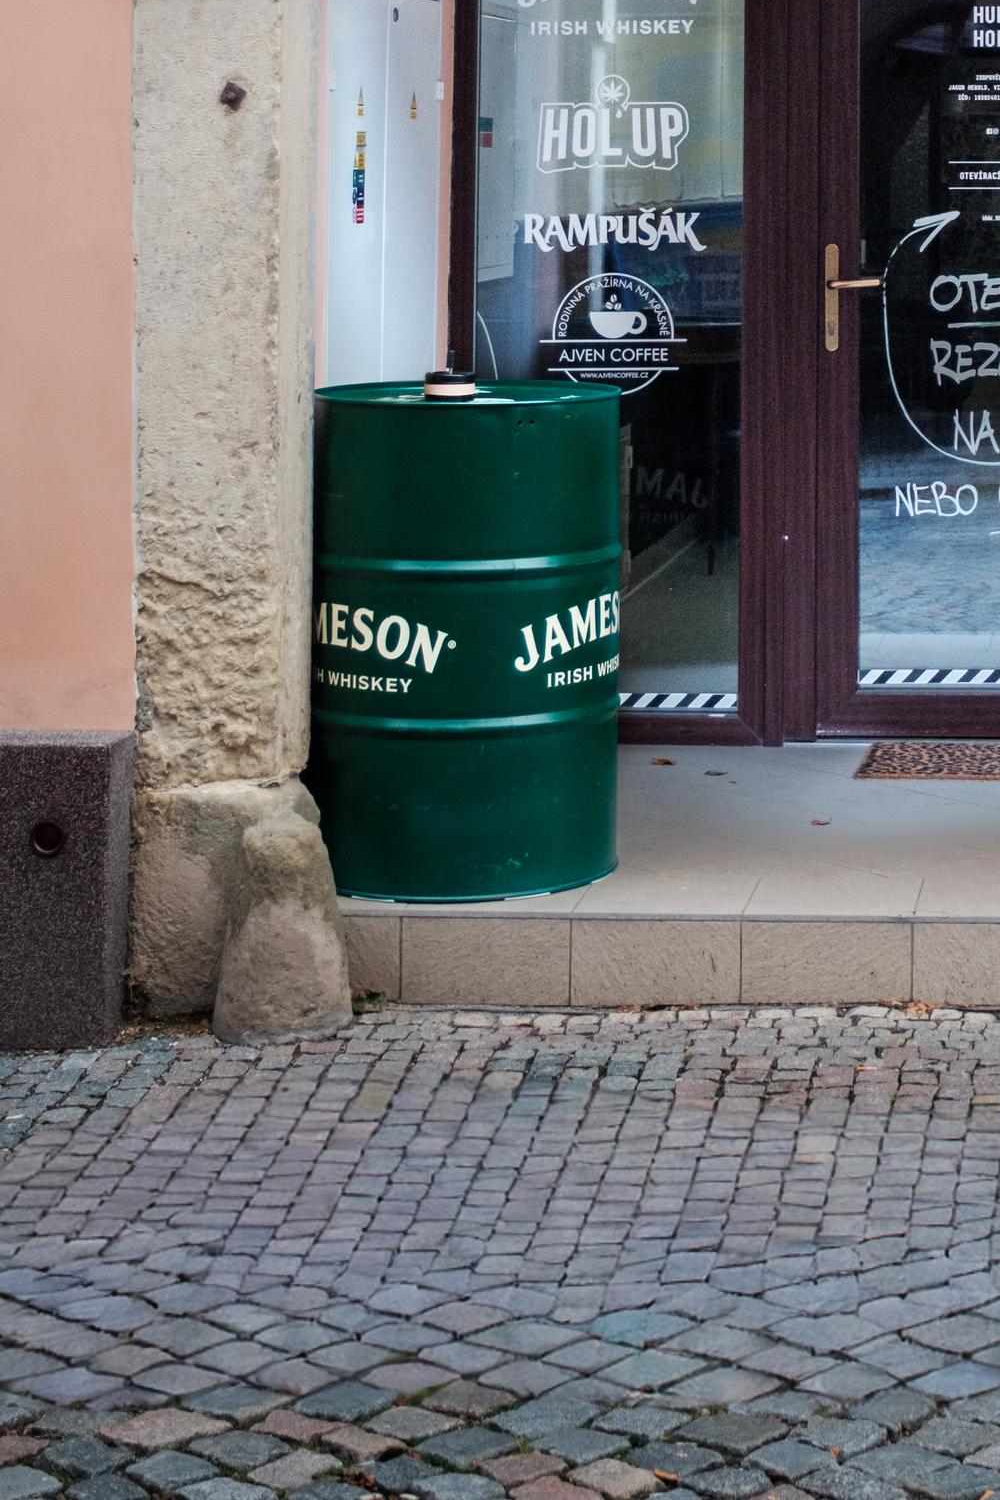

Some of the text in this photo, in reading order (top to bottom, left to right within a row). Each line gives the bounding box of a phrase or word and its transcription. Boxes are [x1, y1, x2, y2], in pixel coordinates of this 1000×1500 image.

[530, 19, 695, 36] IRISH WHISKEY
[524, 207, 708, 252] RAMPUŠÁK
[558, 276, 671, 338] RODINNÁ PRAŽÍRNA NA KRÁSNÉ
[558, 347, 669, 363] AJVEN COFFEE
[953, 408, 1000, 455] NA
[895, 480, 978, 517] NEBO
[328, 668, 413, 693] WHISKEY
[547, 667, 593, 689] IRISH
